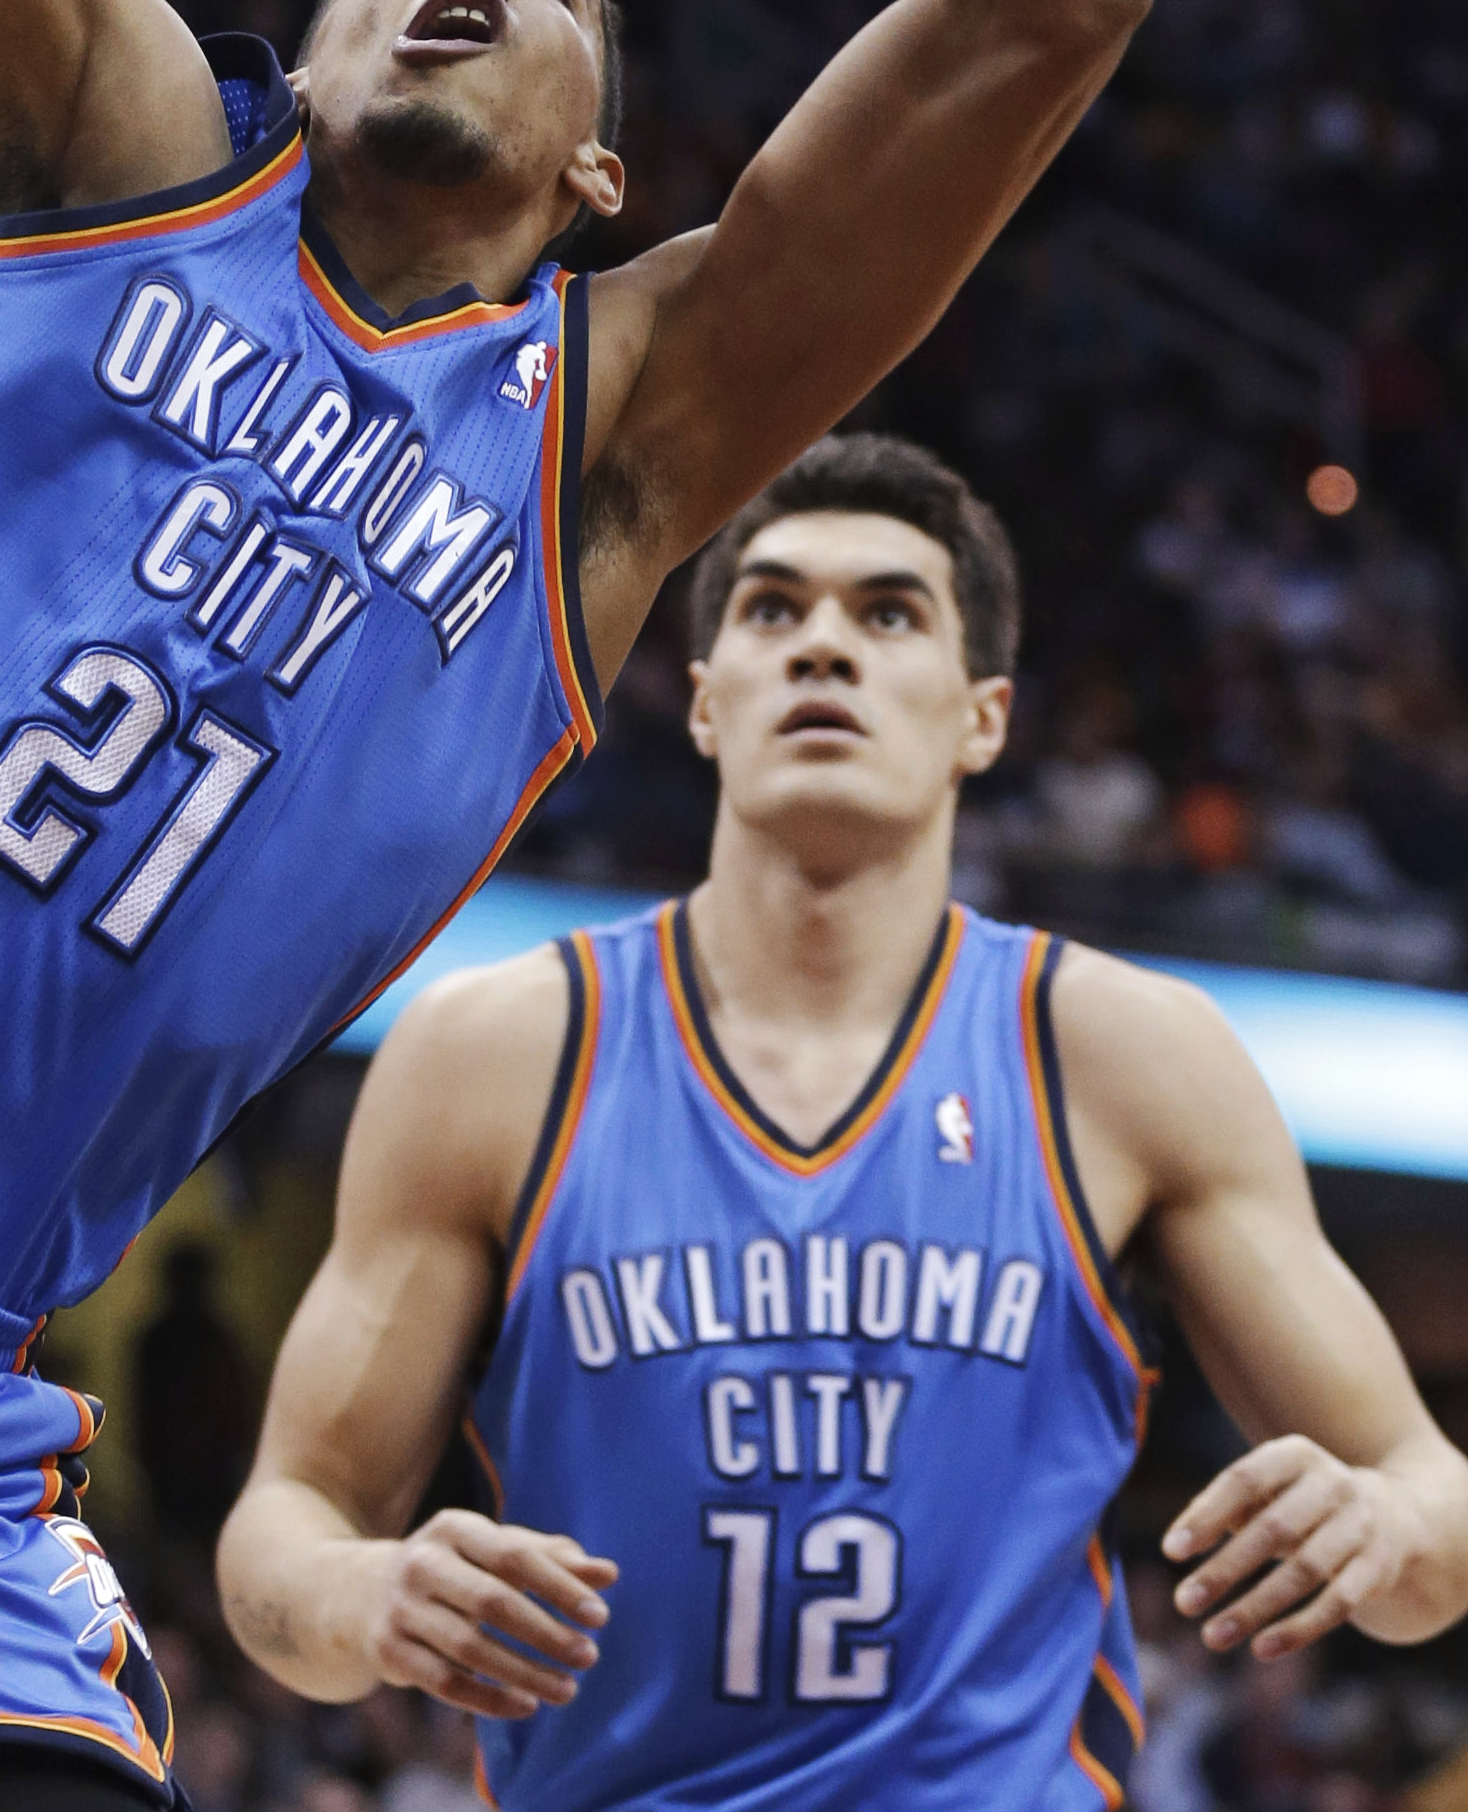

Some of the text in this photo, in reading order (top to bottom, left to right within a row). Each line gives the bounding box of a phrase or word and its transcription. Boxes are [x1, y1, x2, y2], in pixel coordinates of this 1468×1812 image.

[96, 275, 517, 665] OKLAHOMA
[500, 382, 526, 404] NBA
[134, 477, 370, 692] CITY
[563, 1235, 1043, 1367] OKLAHOMA
[707, 1375, 910, 1481] CITY
[702, 1506, 903, 1702] 12
